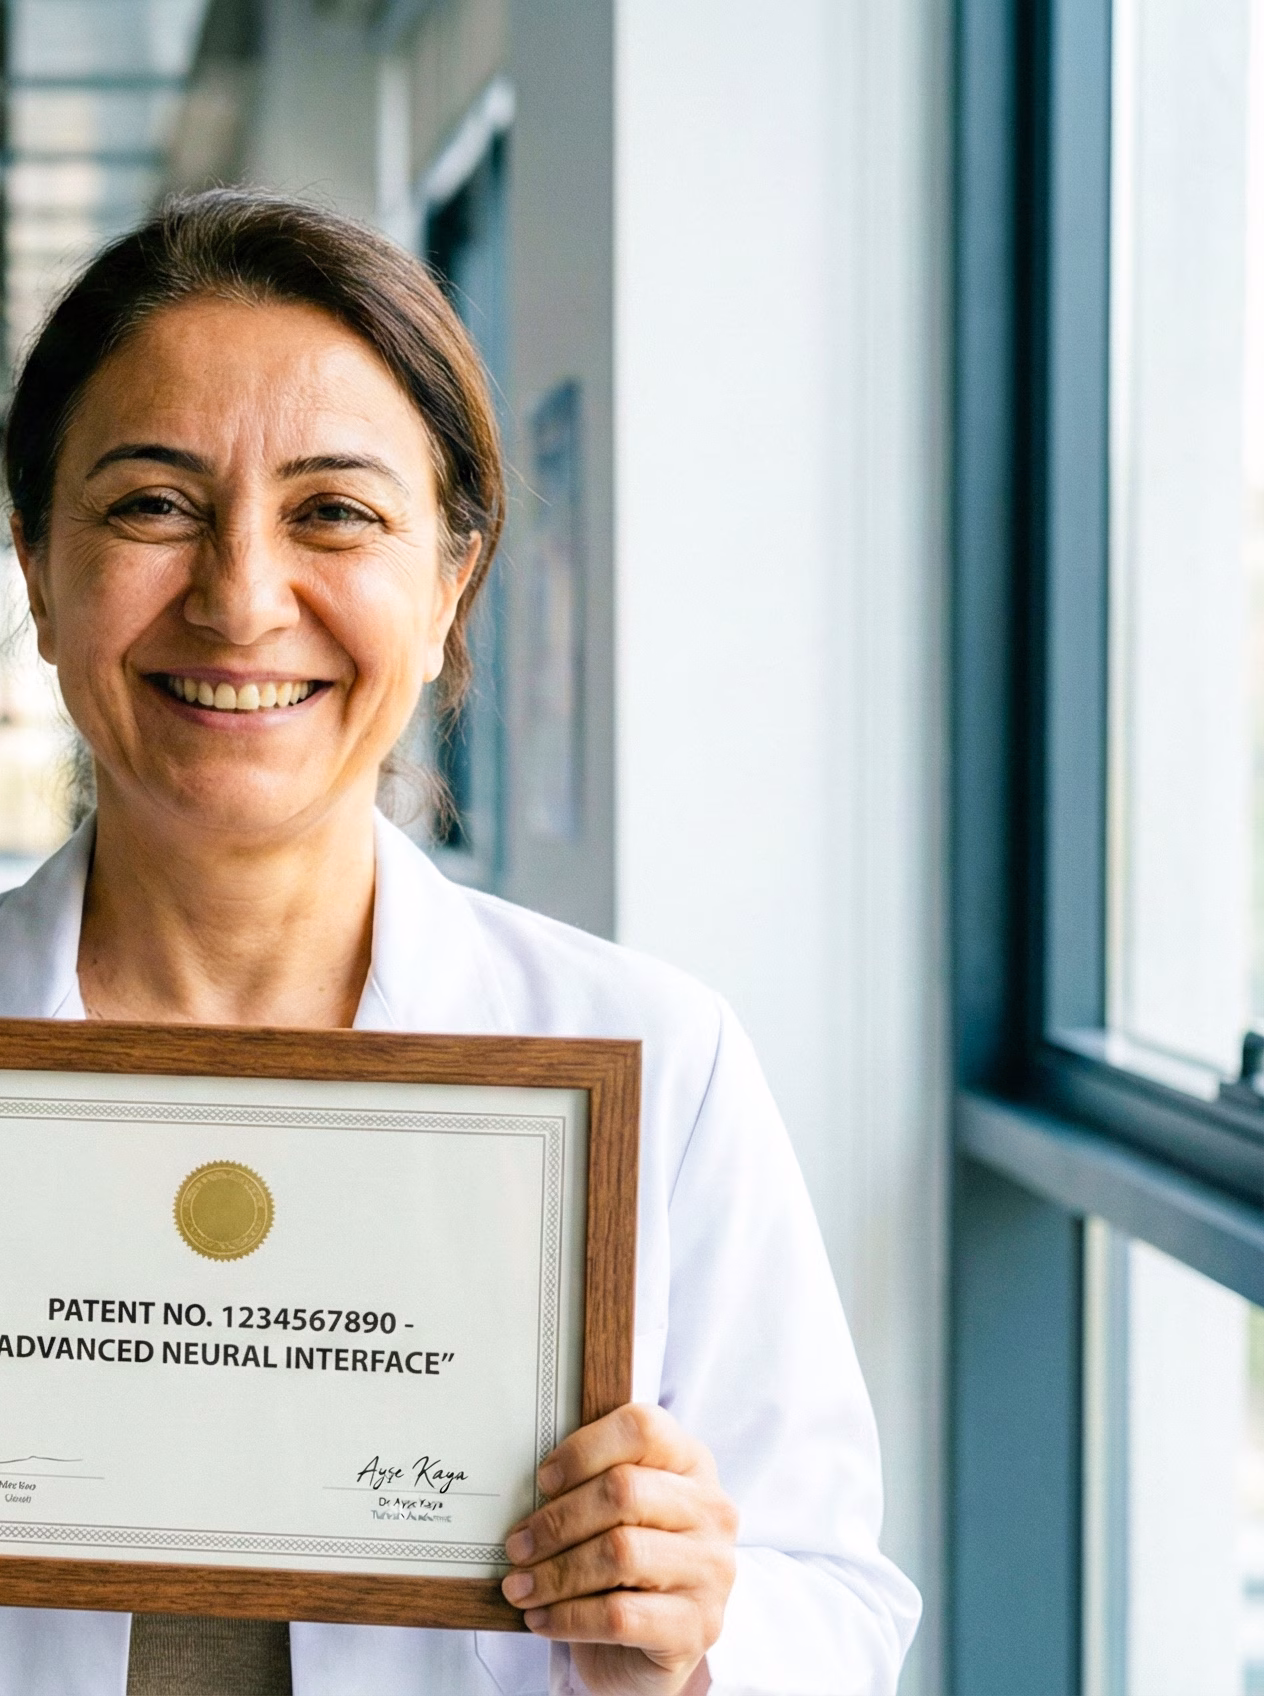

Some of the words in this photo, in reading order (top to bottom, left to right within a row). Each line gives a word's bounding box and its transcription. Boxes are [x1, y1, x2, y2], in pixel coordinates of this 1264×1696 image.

[48, 1297, 156, 1325] PATENT
[163, 1302, 213, 1327] NO.
[222, 1305, 397, 1335] 1234567890
[162, 1341, 278, 1369] NEURAL
[285, 1346, 455, 1375] INTERFACE”
[412, 1455, 468, 1494] Kaya
